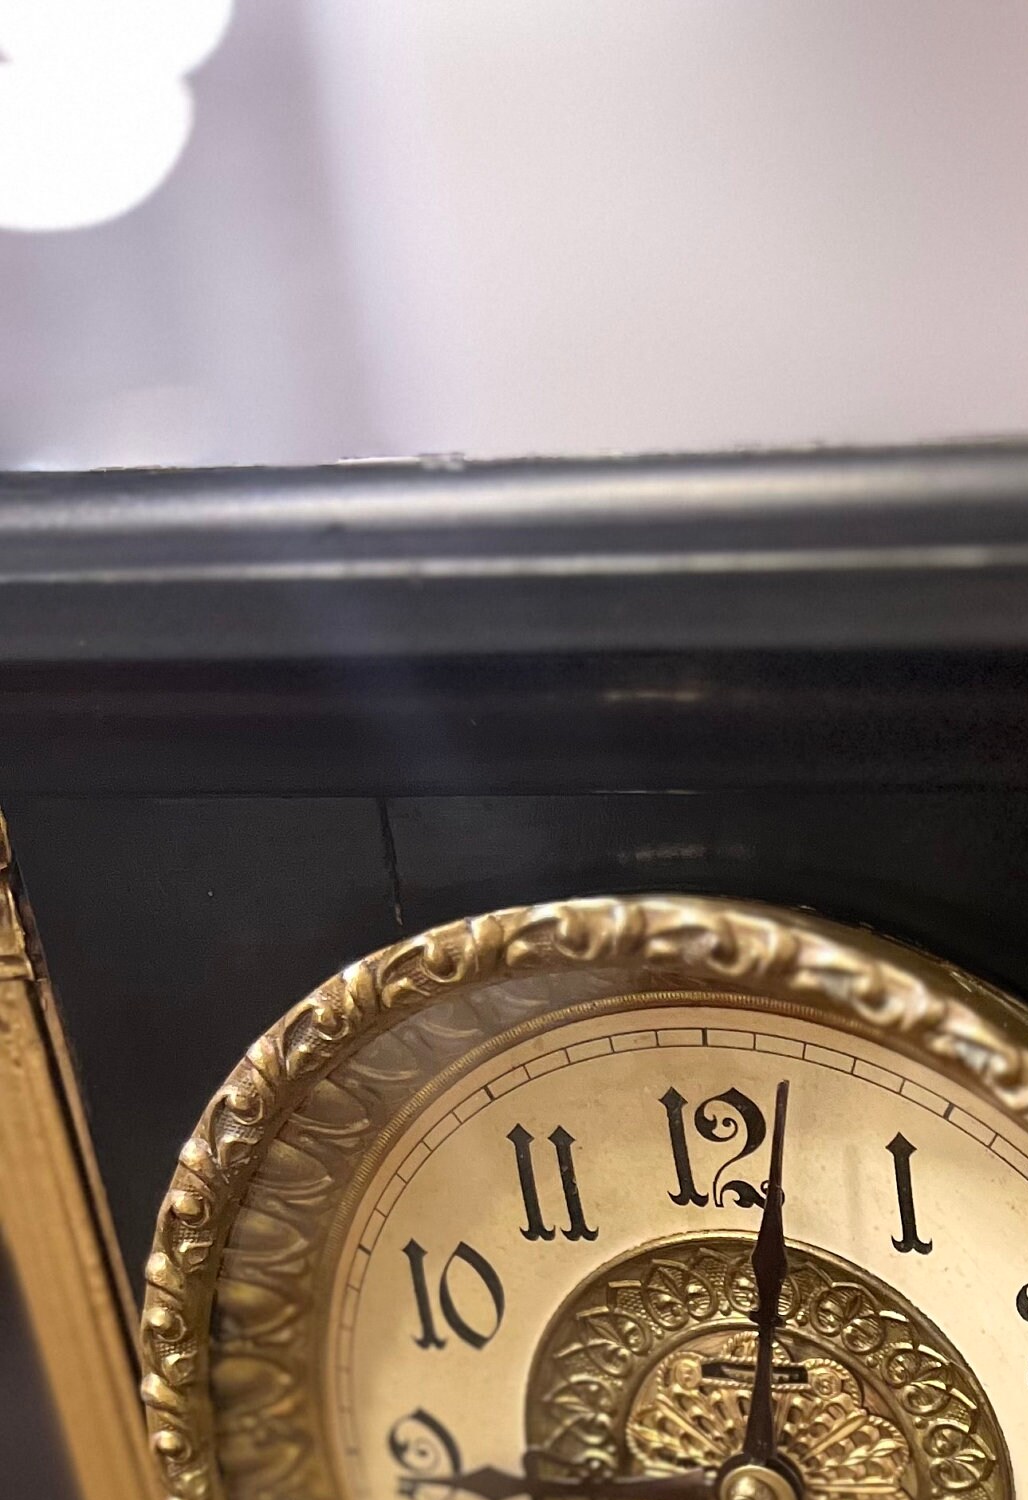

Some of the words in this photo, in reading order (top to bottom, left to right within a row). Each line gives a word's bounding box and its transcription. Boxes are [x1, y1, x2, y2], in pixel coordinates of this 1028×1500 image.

[506, 1124, 599, 1243] 11
[659, 1084, 784, 1209] 12
[885, 1132, 934, 1256] 1
[402, 1239, 506, 1351] 10
